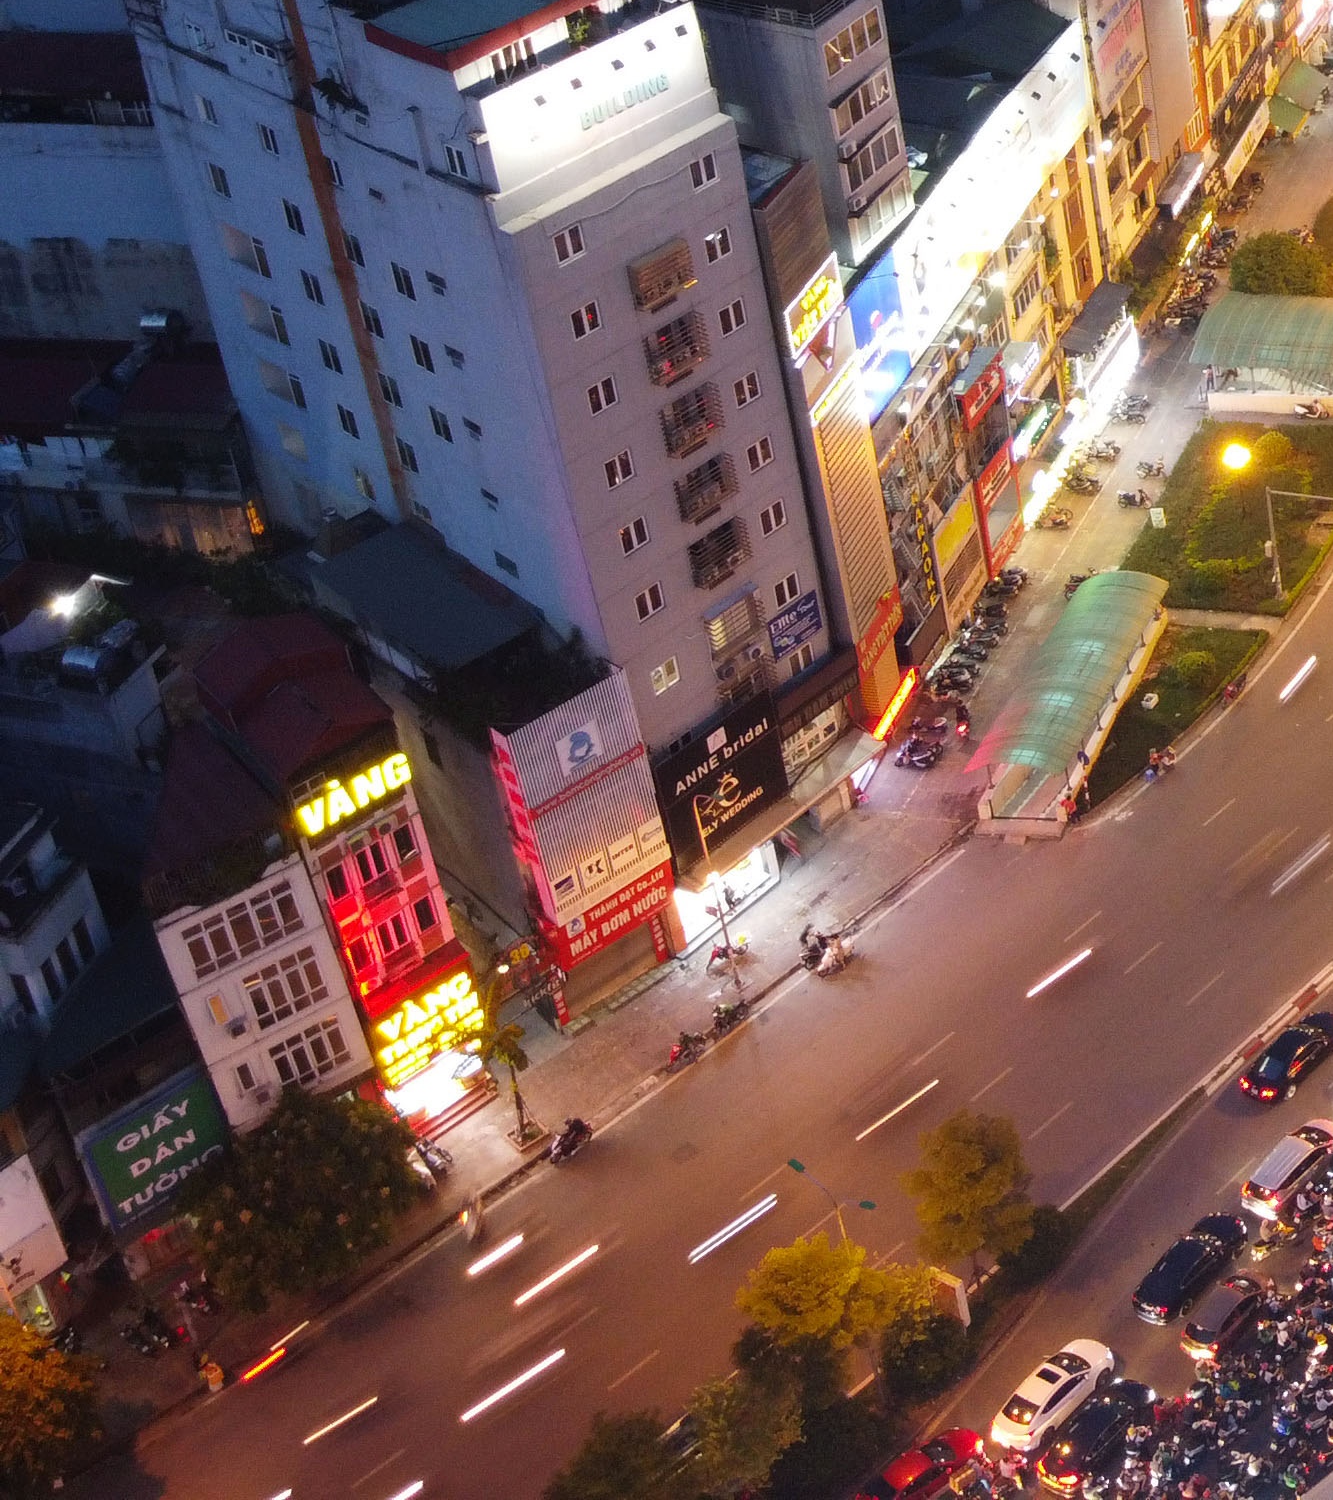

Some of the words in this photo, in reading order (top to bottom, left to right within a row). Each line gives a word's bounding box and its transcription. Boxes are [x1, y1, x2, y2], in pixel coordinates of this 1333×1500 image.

[580, 73, 670, 131] BUILDING
[675, 757, 721, 797] ANNE
[723, 717, 770, 759] bridal
[296, 752, 413, 837] VÀNG
[720, 785, 765, 824] WEDDING
[569, 927, 598, 957] MÁY
[601, 909, 633, 940] BƠM
[632, 884, 668, 919] NƯỚC
[588, 896, 619, 923] THÀNH
[619, 886, 637, 910] ĐẠT
[376, 971, 472, 1043] VÀNG
[115, 1098, 190, 1153] GIẤY
[129, 1128, 197, 1179] DÁN
